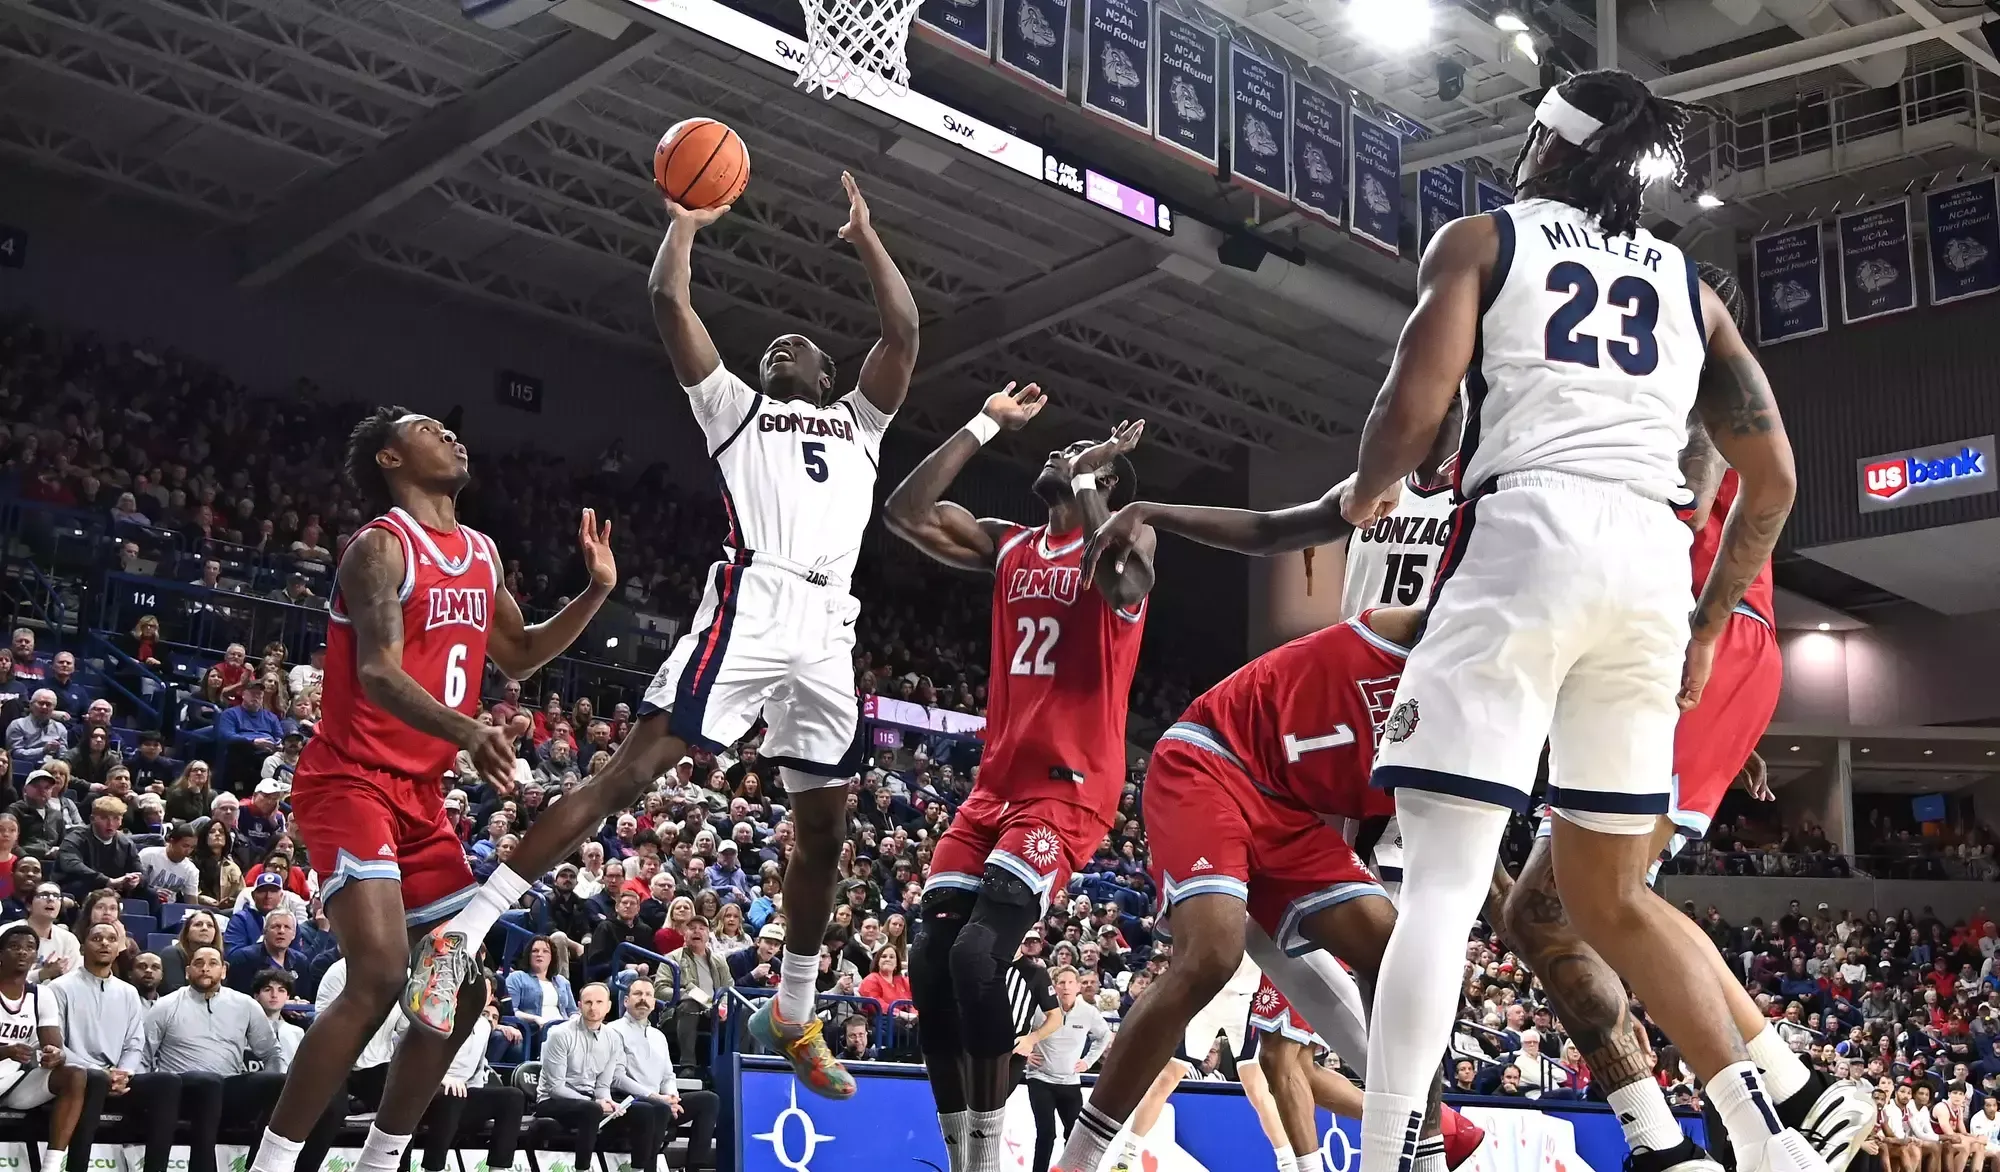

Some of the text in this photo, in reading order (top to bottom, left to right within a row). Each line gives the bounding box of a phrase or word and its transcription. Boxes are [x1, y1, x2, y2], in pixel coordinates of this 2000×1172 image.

[1106, 8, 1133, 29] NCAA
[1094, 17, 1146, 49] 2nd Round
[1174, 44, 1201, 64] NCAA
[1163, 53, 1213, 84] 2nd Round
[1247, 82, 1271, 101] NCAA
[1236, 90, 1282, 120] 2nd Round
[1307, 112, 1330, 130] NCAA
[1365, 144, 1388, 162] NCAA
[1431, 178, 1454, 195] NCAA
[1136, 200, 1145, 216] 4
[1948, 206, 1977, 221] NCAA
[1852, 217, 1895, 232] BASKETBALL
[1937, 213, 1990, 233] Third Round
[1846, 234, 1906, 256] Second Round
[1862, 230, 1888, 242] NCAA
[1540, 222, 1662, 272] MILLER
[1775, 252, 1800, 263] NCAA
[1544, 260, 1660, 376] 23
[510, 381, 533, 402] 115
[802, 441, 829, 483] 5
[1868, 447, 1982, 491] us bank
[1360, 516, 1450, 546] GONZAG
[1007, 566, 1082, 606] LMU
[1380, 554, 1428, 606] 15
[134, 592, 156, 608] 114
[424, 588, 488, 632] LMU
[1010, 616, 1060, 676] 22
[444, 644, 468, 708] 6
[880, 732, 894, 744] 115
[1283, 722, 1356, 764] 1
[0, 1022, 34, 1040] ZAGA
[523, 1072, 538, 1084] RE
